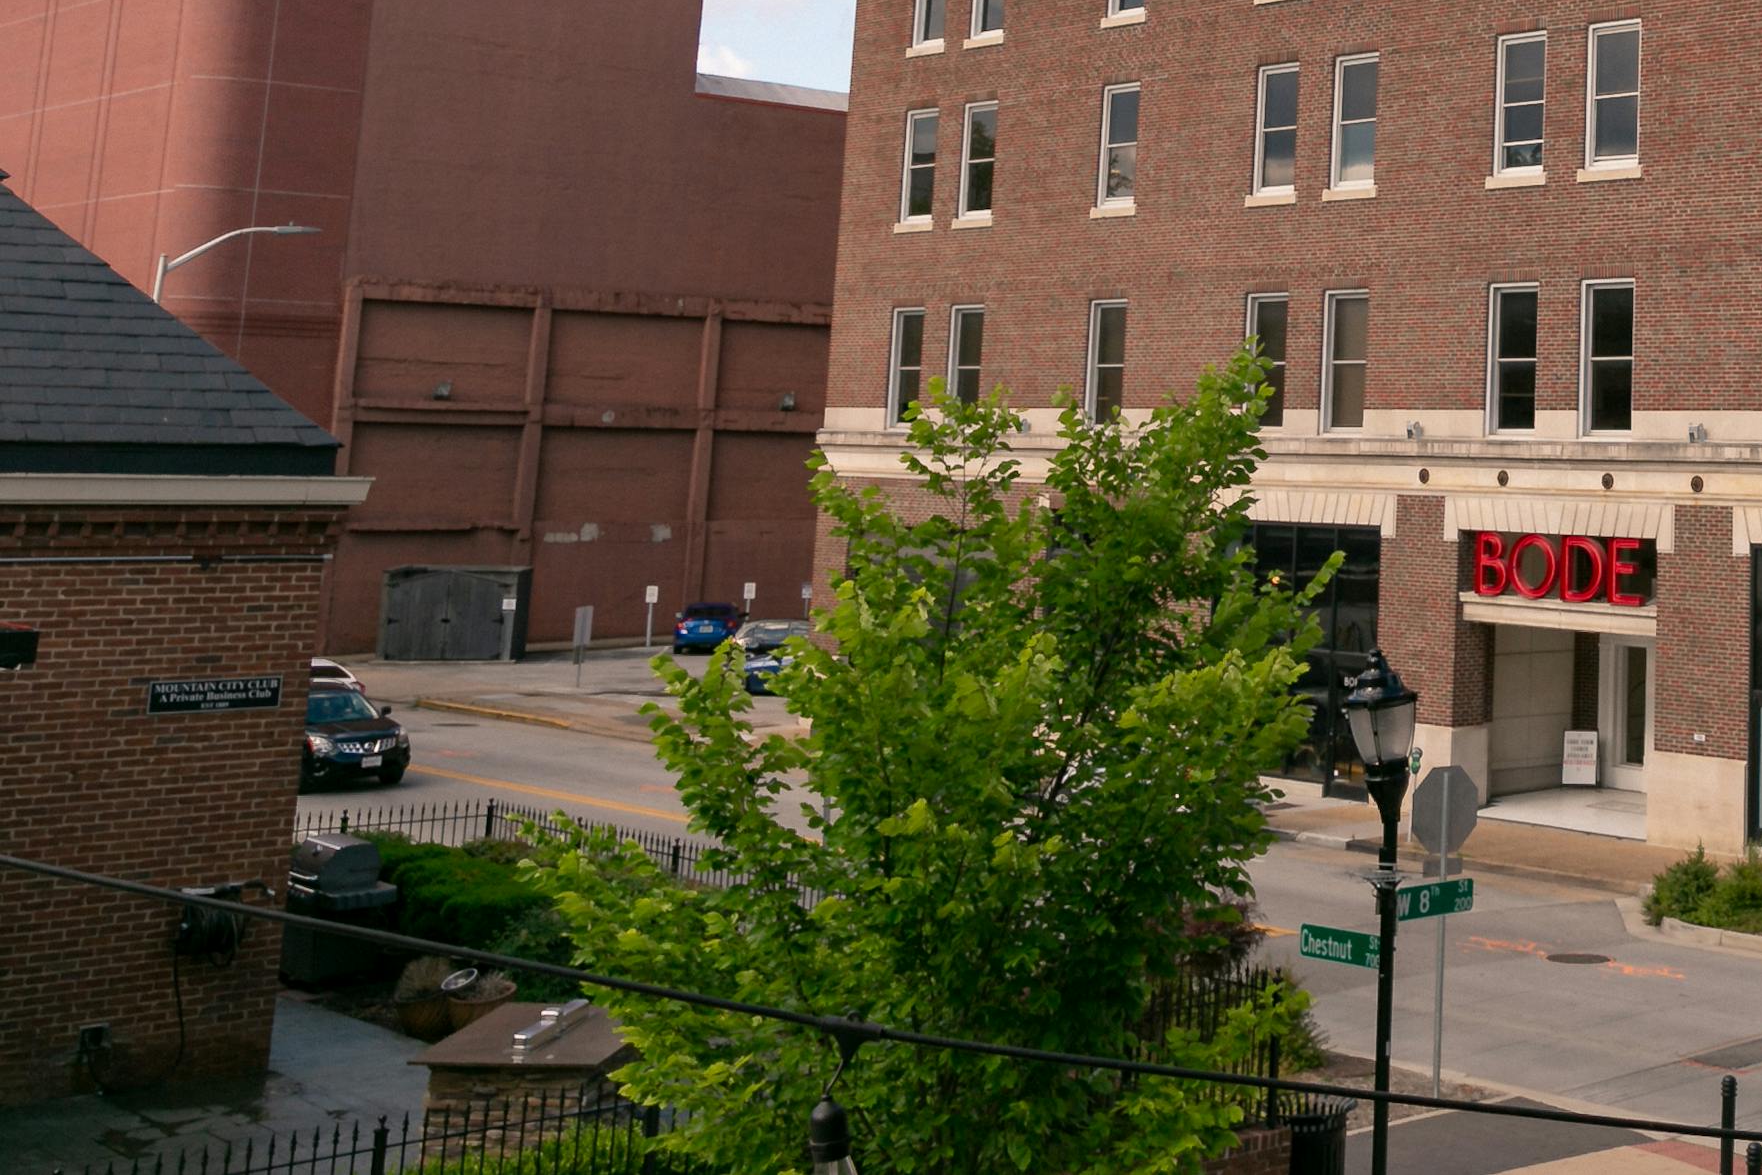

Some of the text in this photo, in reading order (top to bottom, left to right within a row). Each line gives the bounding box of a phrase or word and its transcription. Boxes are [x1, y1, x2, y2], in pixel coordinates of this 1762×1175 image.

[1474, 530, 1646, 607] BODE
[155, 679, 278, 693] MOUNTAIN CITY CLUB
[160, 689, 271, 703] A Private Business Club
[1396, 893, 1411, 917] W
[1458, 879, 1469, 893] St
[1454, 896, 1473, 912] 200
[1301, 928, 1353, 960] Chestnut
